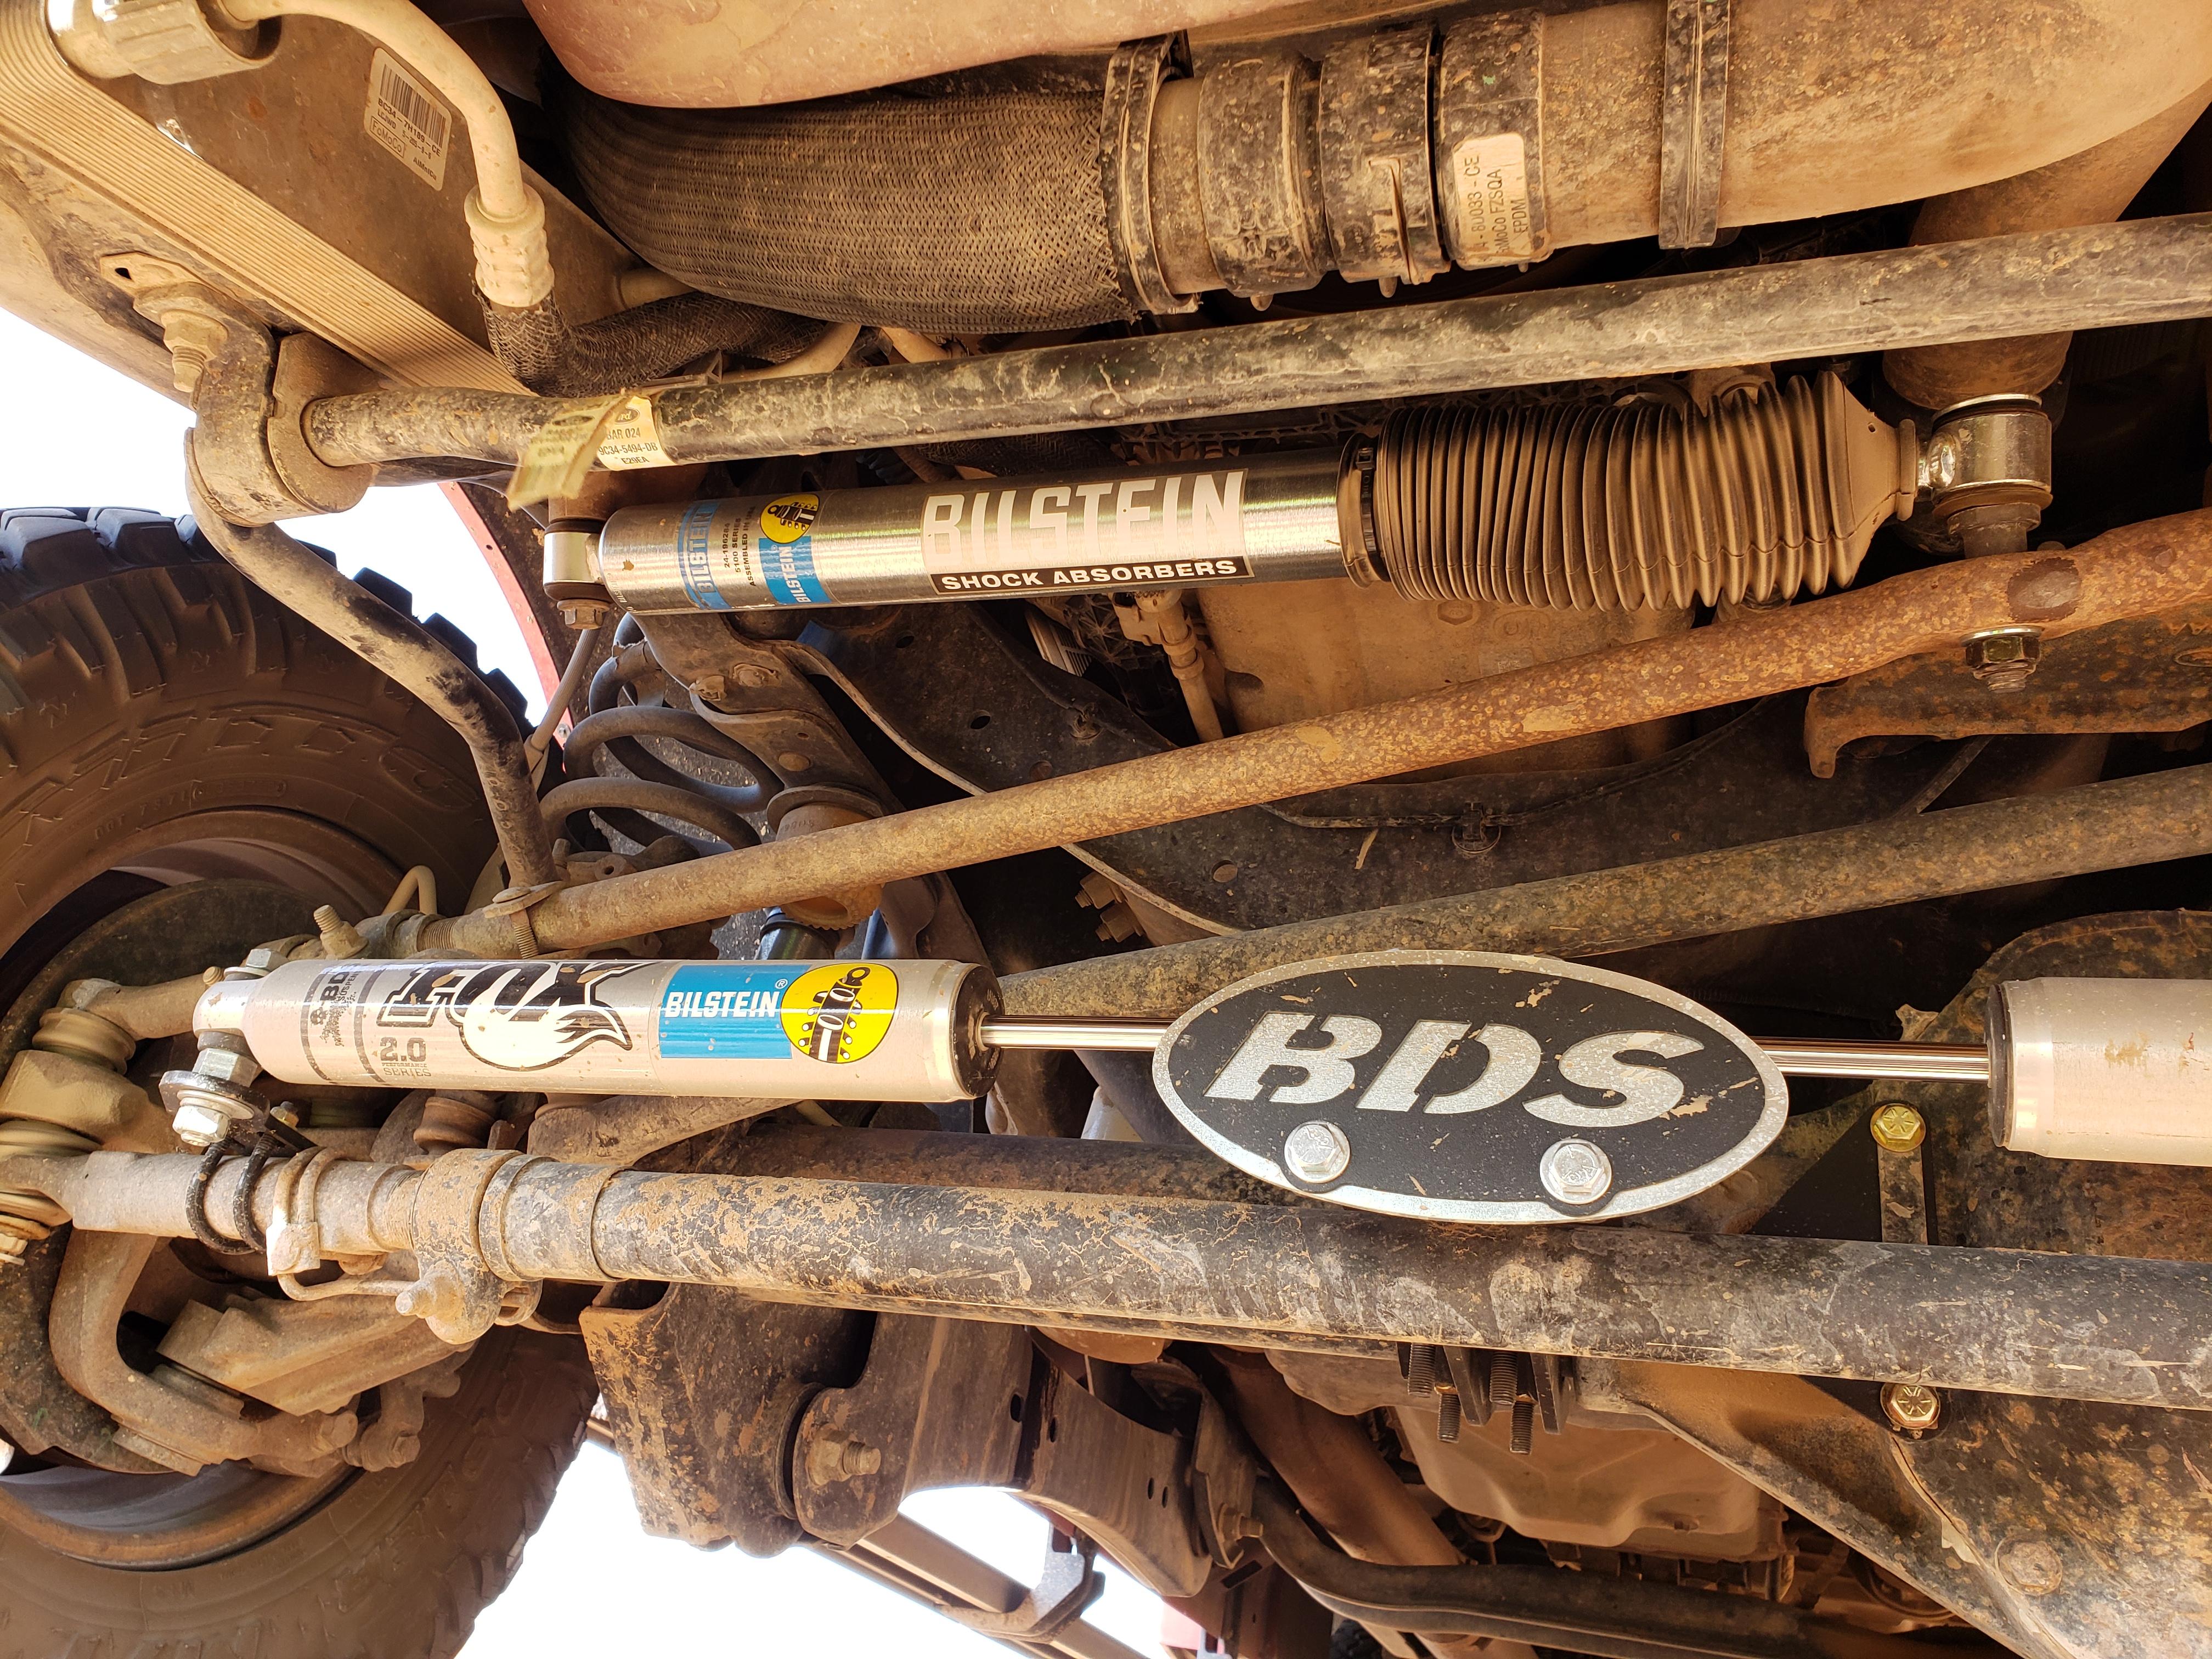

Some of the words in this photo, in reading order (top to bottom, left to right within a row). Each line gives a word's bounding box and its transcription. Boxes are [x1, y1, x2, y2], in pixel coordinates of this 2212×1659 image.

[372, 122, 402, 153] FoMoCo
[732, 518, 741, 549] SERIES
[923, 471, 1244, 569] BILSTEIN
[689, 508, 716, 593] BILSTEIN
[732, 551, 741, 573] 5100
[742, 534, 757, 587] ASSEMBLED
[778, 546, 812, 603] BILSTEIN
[941, 572, 1043, 590] SHOCK
[1053, 560, 1238, 585] ABSORBERS
[664, 991, 780, 1018] BILSTEIN
[380, 1036, 427, 1062] 2.0
[383, 1067, 432, 1077] SERIES
[1204, 1012, 1706, 1127] BDS
